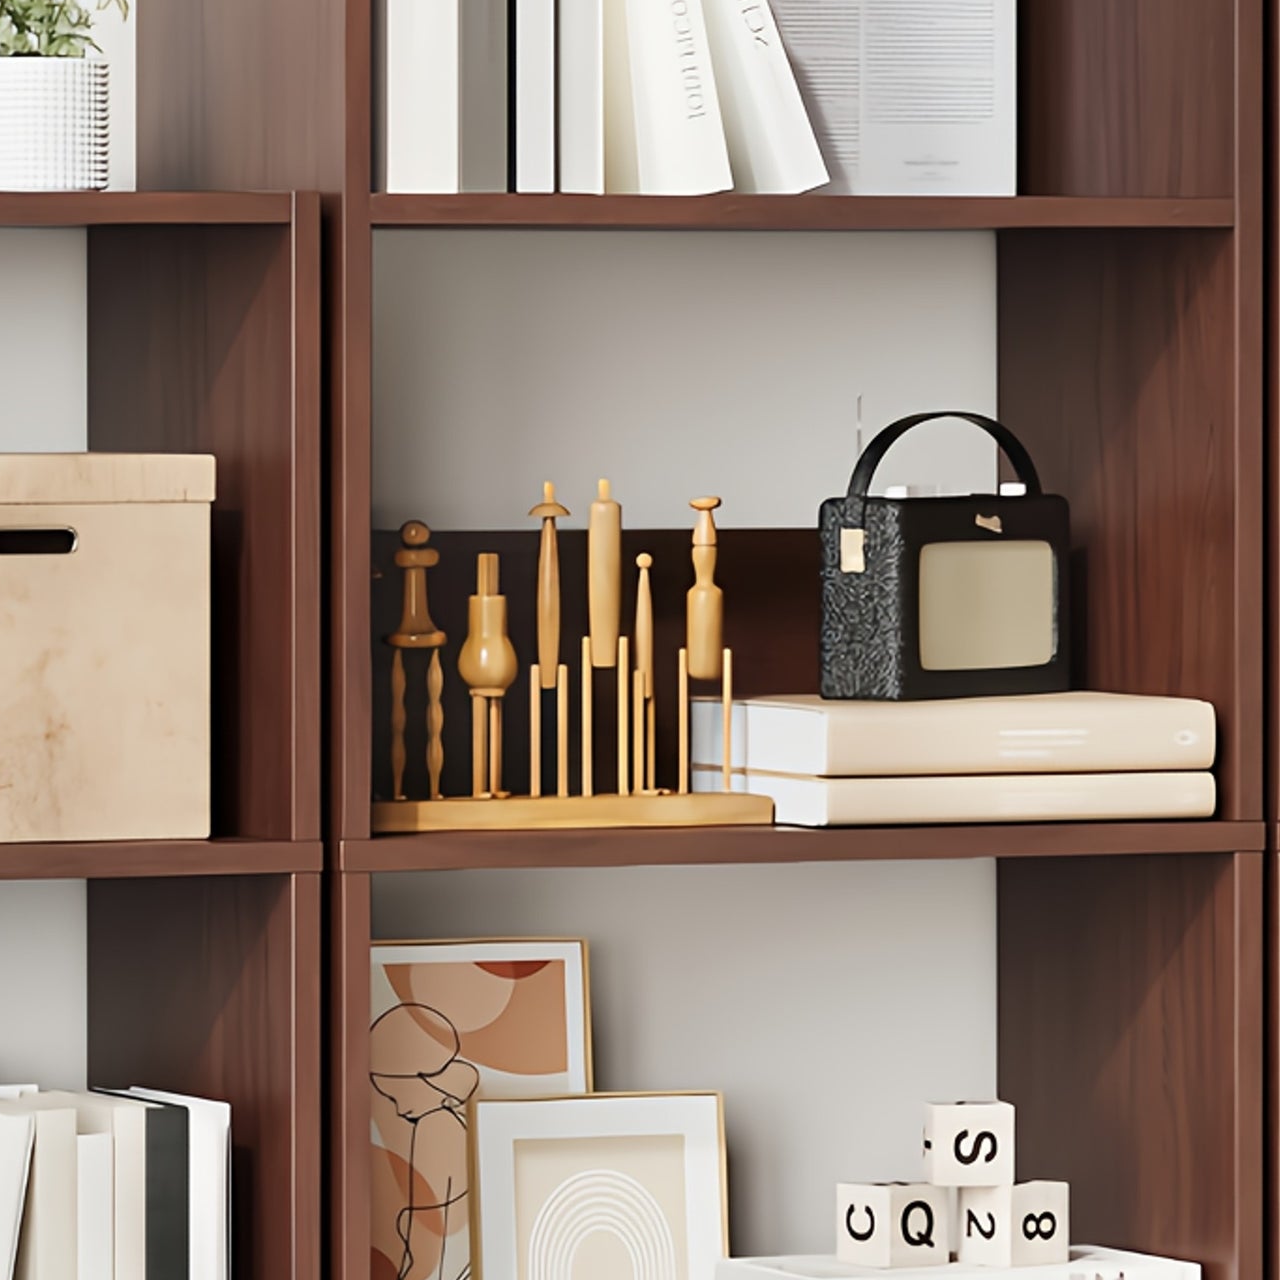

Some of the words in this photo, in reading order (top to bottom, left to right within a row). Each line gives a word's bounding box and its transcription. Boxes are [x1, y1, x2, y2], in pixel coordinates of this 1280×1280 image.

[953, 1128, 998, 1166] S
[845, 1203, 875, 1241] C
[900, 1200, 935, 1248] Q
[1022, 1211, 1057, 1241] 8
